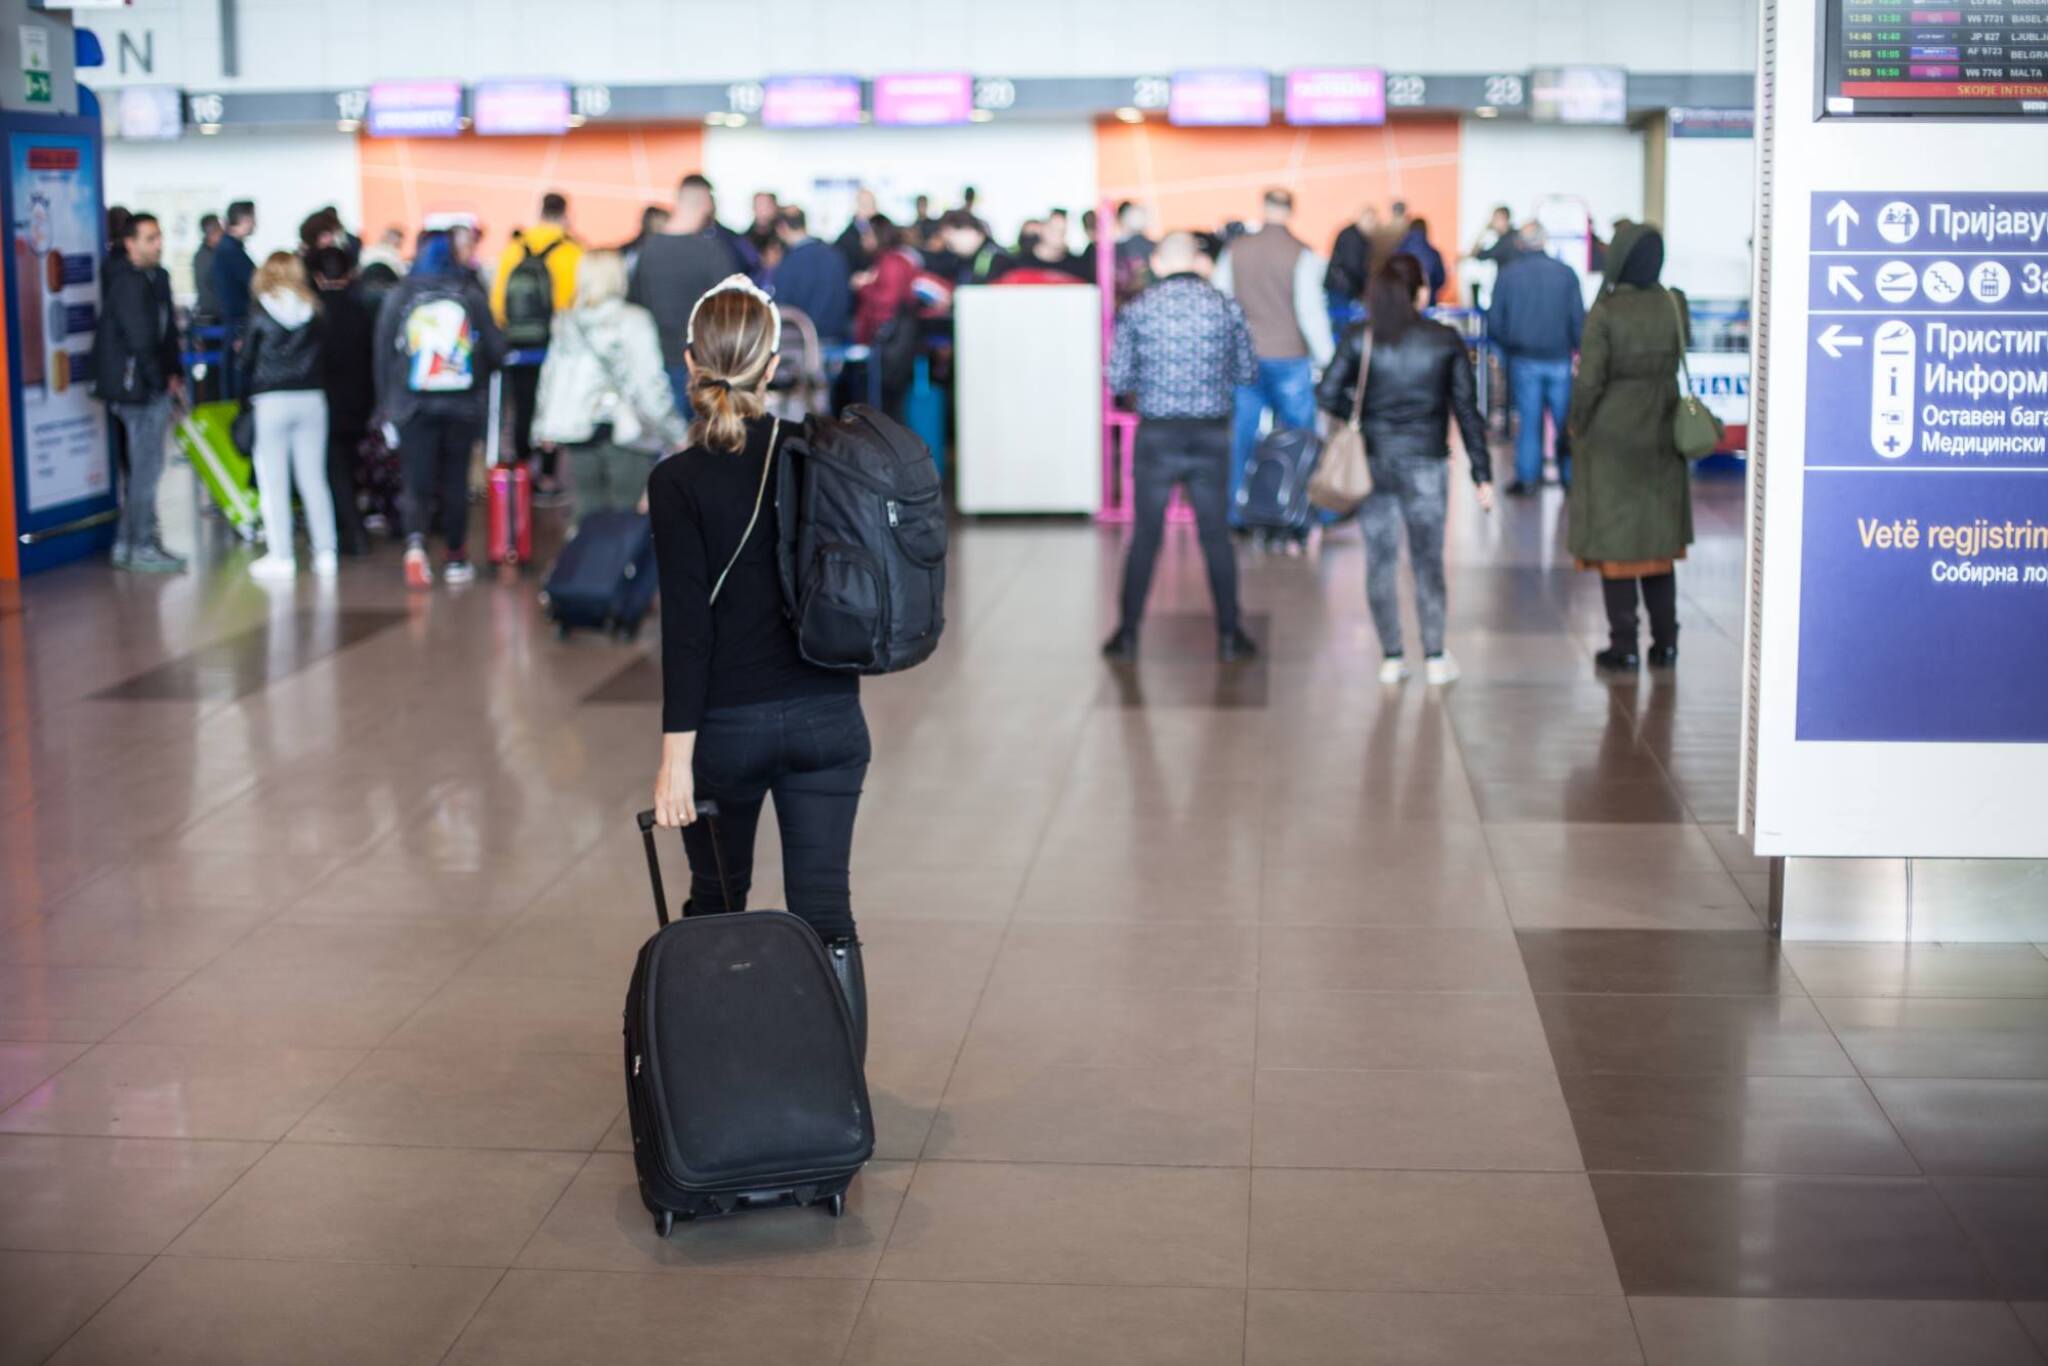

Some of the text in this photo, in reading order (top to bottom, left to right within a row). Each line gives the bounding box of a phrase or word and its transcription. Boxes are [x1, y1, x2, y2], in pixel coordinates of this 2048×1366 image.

[2010, 68, 2043, 77] MALTA
[1957, 85, 1998, 97] SKOPJE
[1929, 203, 2048, 242] Пријаву
[1926, 322, 2048, 360] Пристиг
[1924, 363, 2048, 400] Информ
[1922, 405, 2005, 426] Оставен
[1922, 432, 2045, 456] Медицински
[1857, 518, 1919, 549] Vetë
[1931, 561, 2048, 586] Собирна ло
